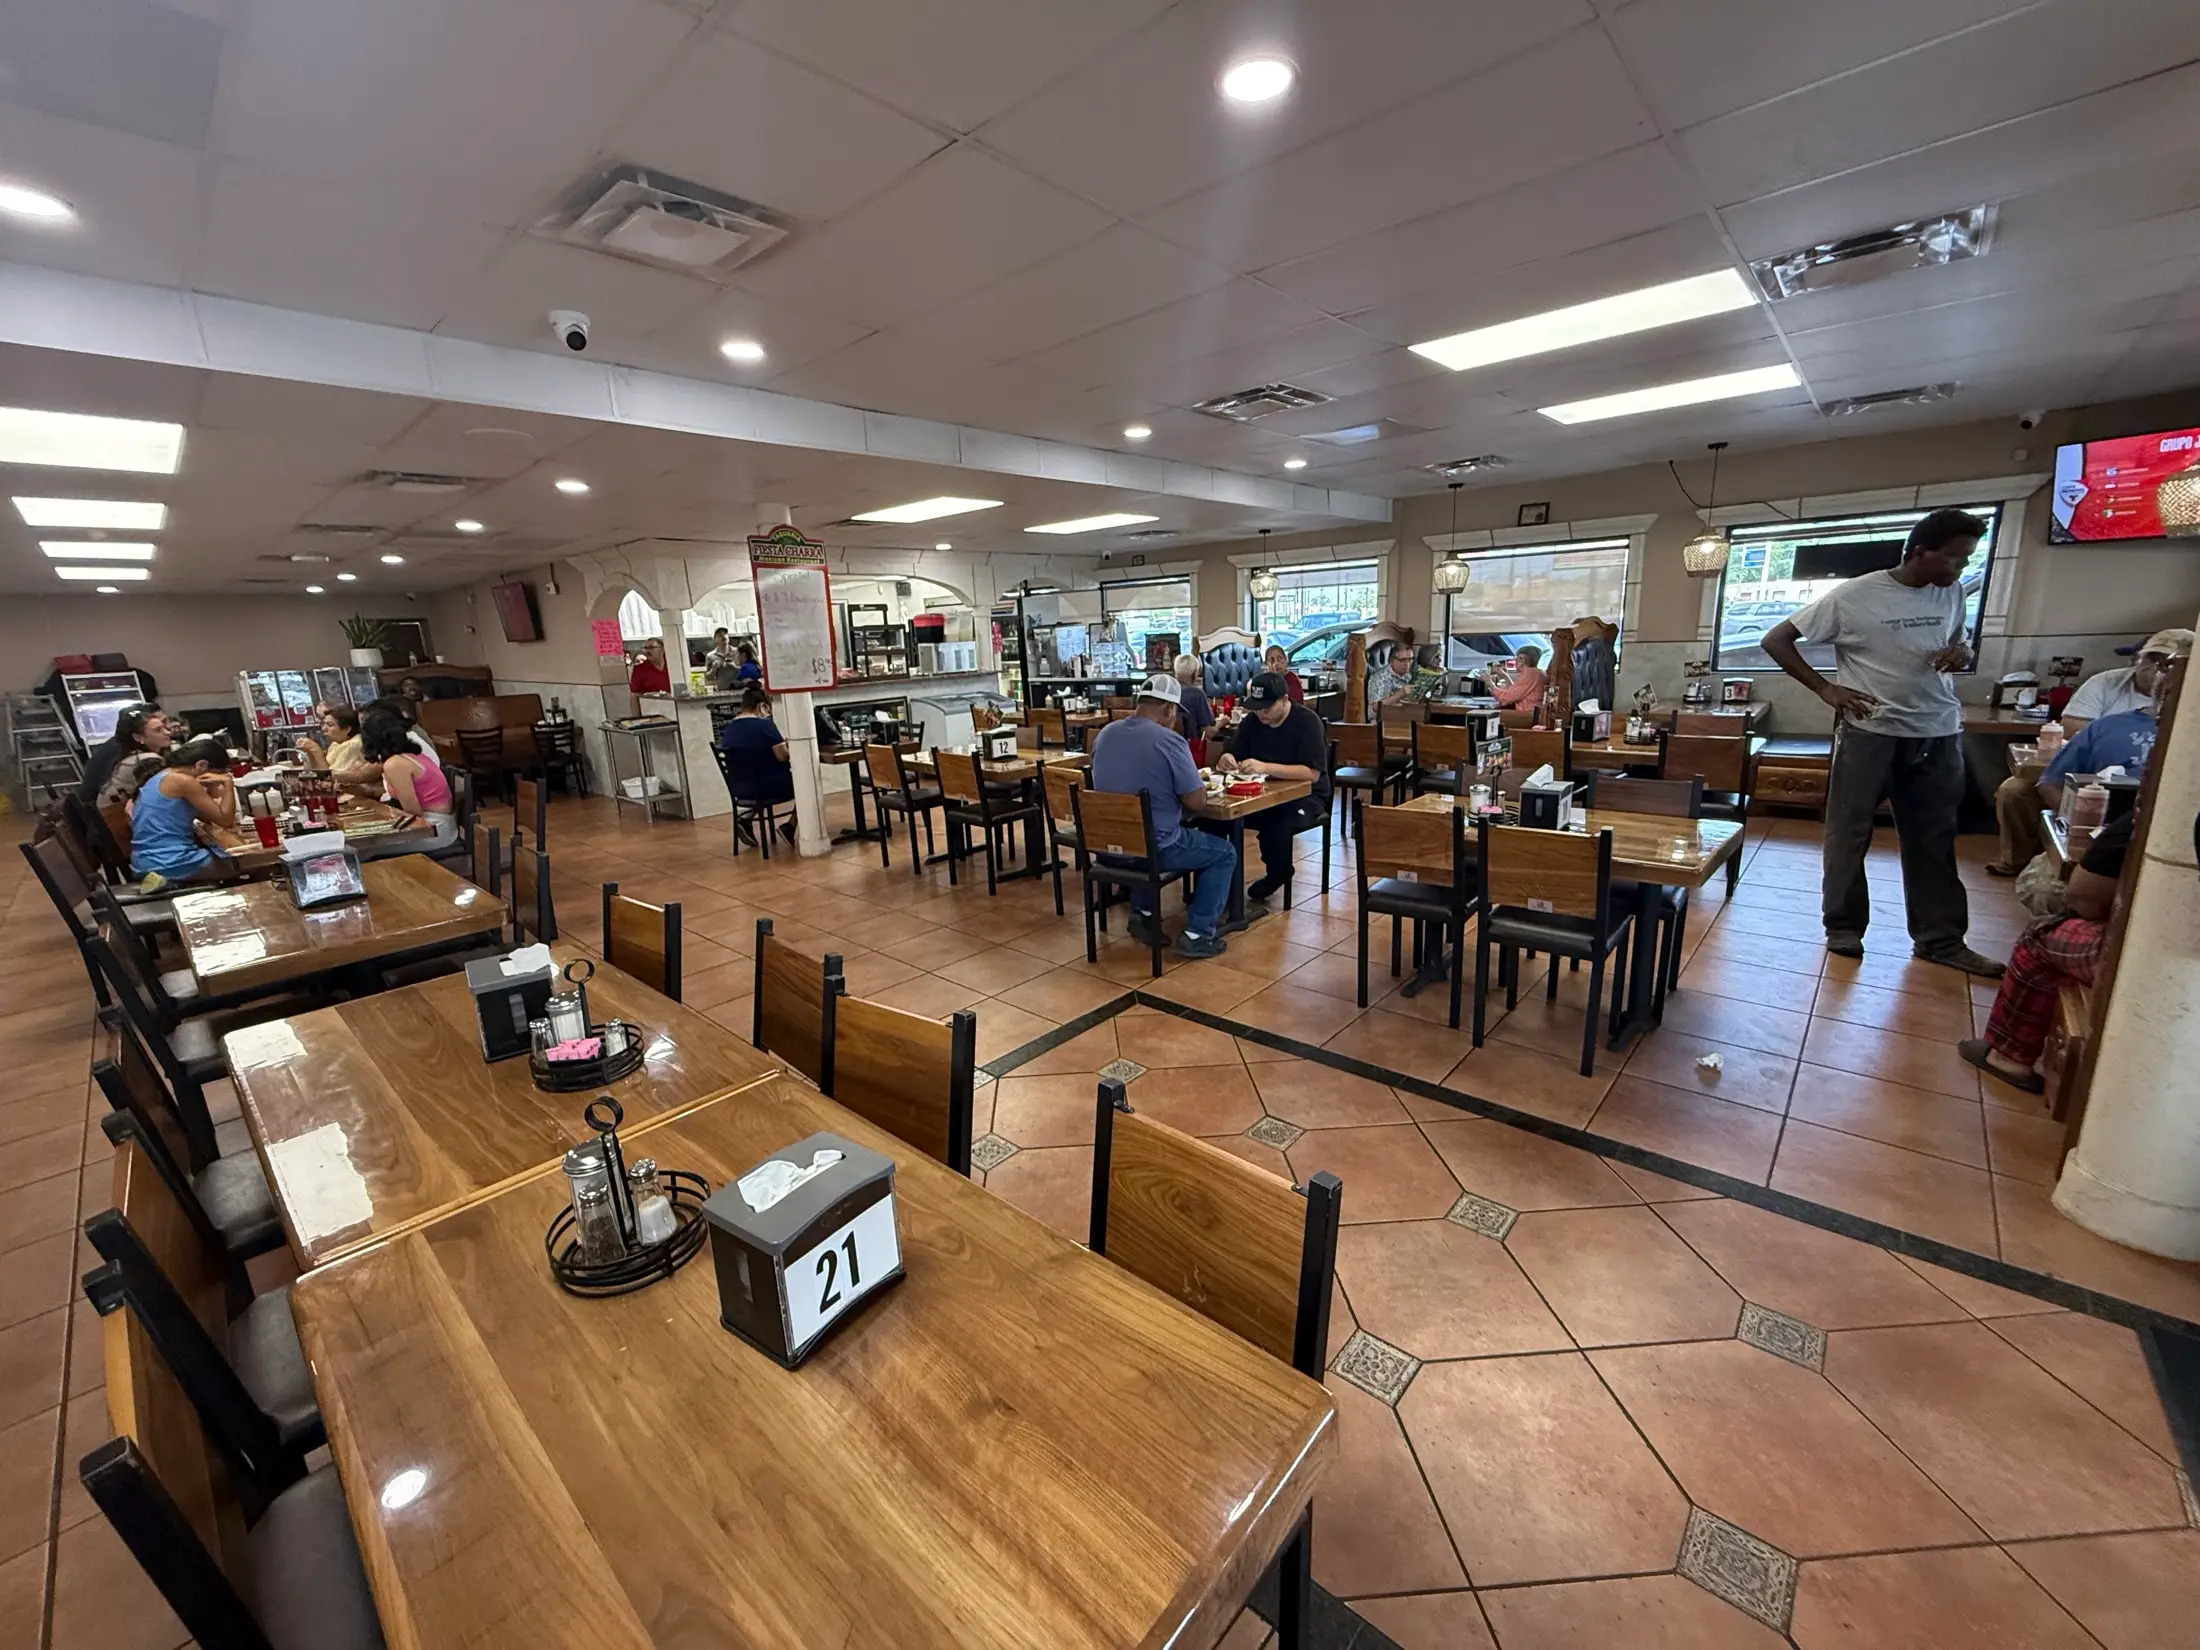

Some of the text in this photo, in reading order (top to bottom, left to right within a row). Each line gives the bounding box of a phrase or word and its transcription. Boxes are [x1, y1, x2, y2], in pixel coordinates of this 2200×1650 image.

[2160, 436, 2193, 452] GRUPO
[773, 531, 801, 542] TAQUERIA
[753, 544, 823, 558] FIESTA CHARRA
[787, 557, 820, 565] Restaurant
[1726, 688, 1733, 698] 3
[999, 741, 1009, 754] 12
[815, 1230, 860, 1315] 21
